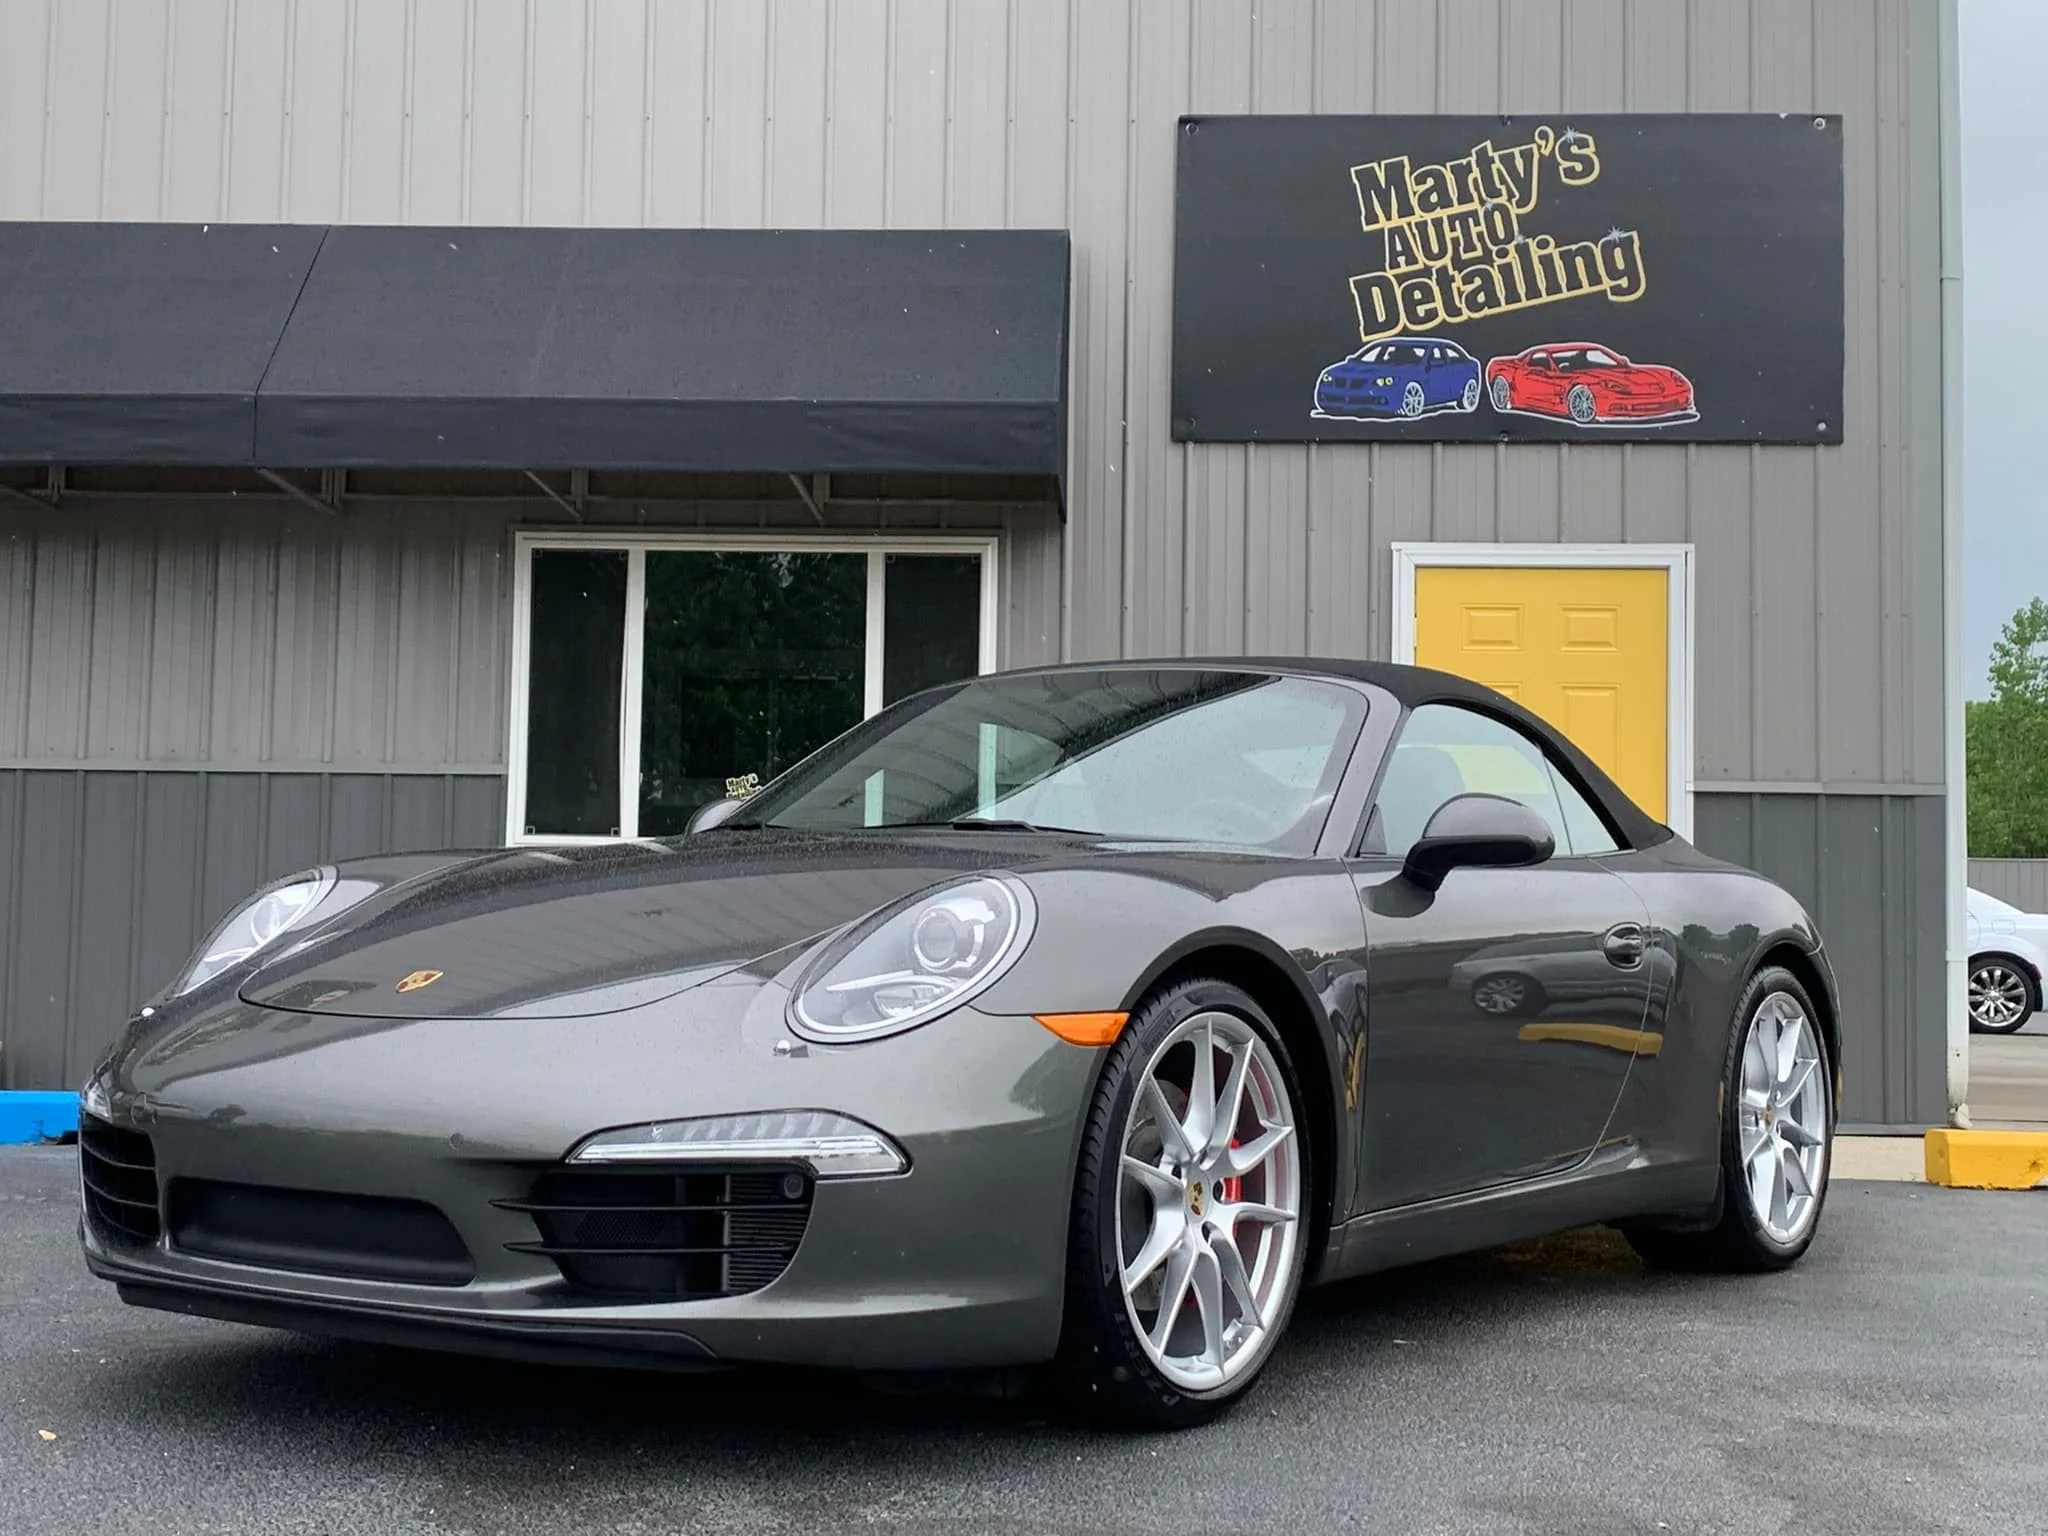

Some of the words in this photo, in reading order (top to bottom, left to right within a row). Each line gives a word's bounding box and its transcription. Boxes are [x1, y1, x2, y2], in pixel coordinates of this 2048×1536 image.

[1350, 125, 1600, 232] Marty's
[1349, 230, 1646, 342] Detailing
[1384, 202, 1517, 275] AUTO
